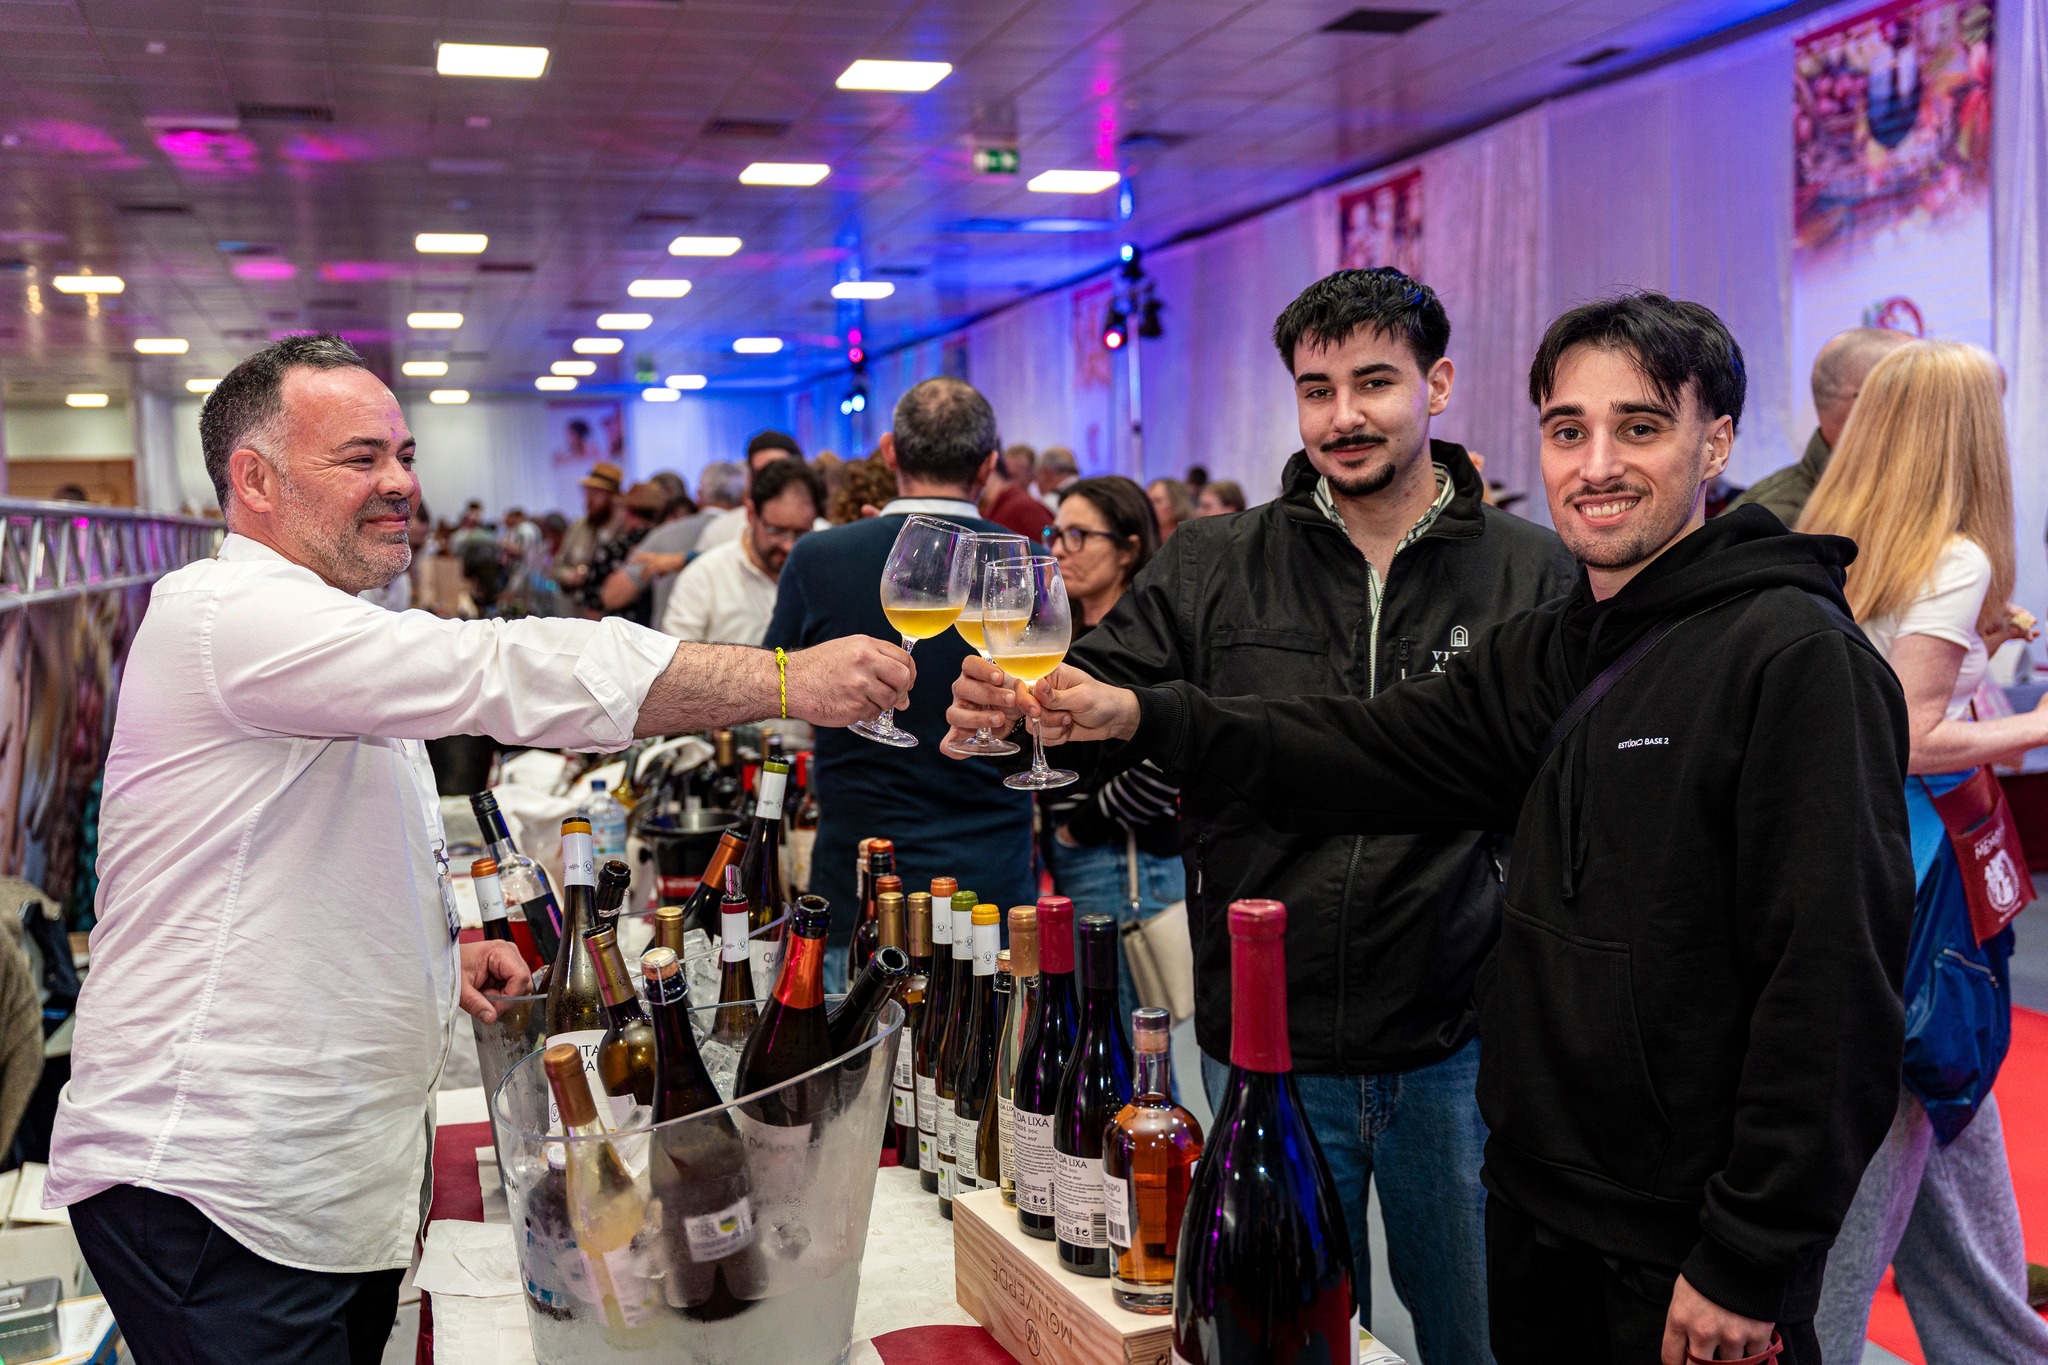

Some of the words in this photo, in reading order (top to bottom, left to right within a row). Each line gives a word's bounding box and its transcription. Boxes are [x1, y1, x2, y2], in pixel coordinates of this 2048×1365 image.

[1618, 739, 1643, 749] ESTÚDIO
[1017, 1112, 1026, 1124] DA
[1028, 1116, 1049, 1127] LIXA
[1060, 1156, 1068, 1164] DA
[1069, 1159, 1087, 1169] LIXA
[990, 1258, 1073, 1348] MONVERDE
